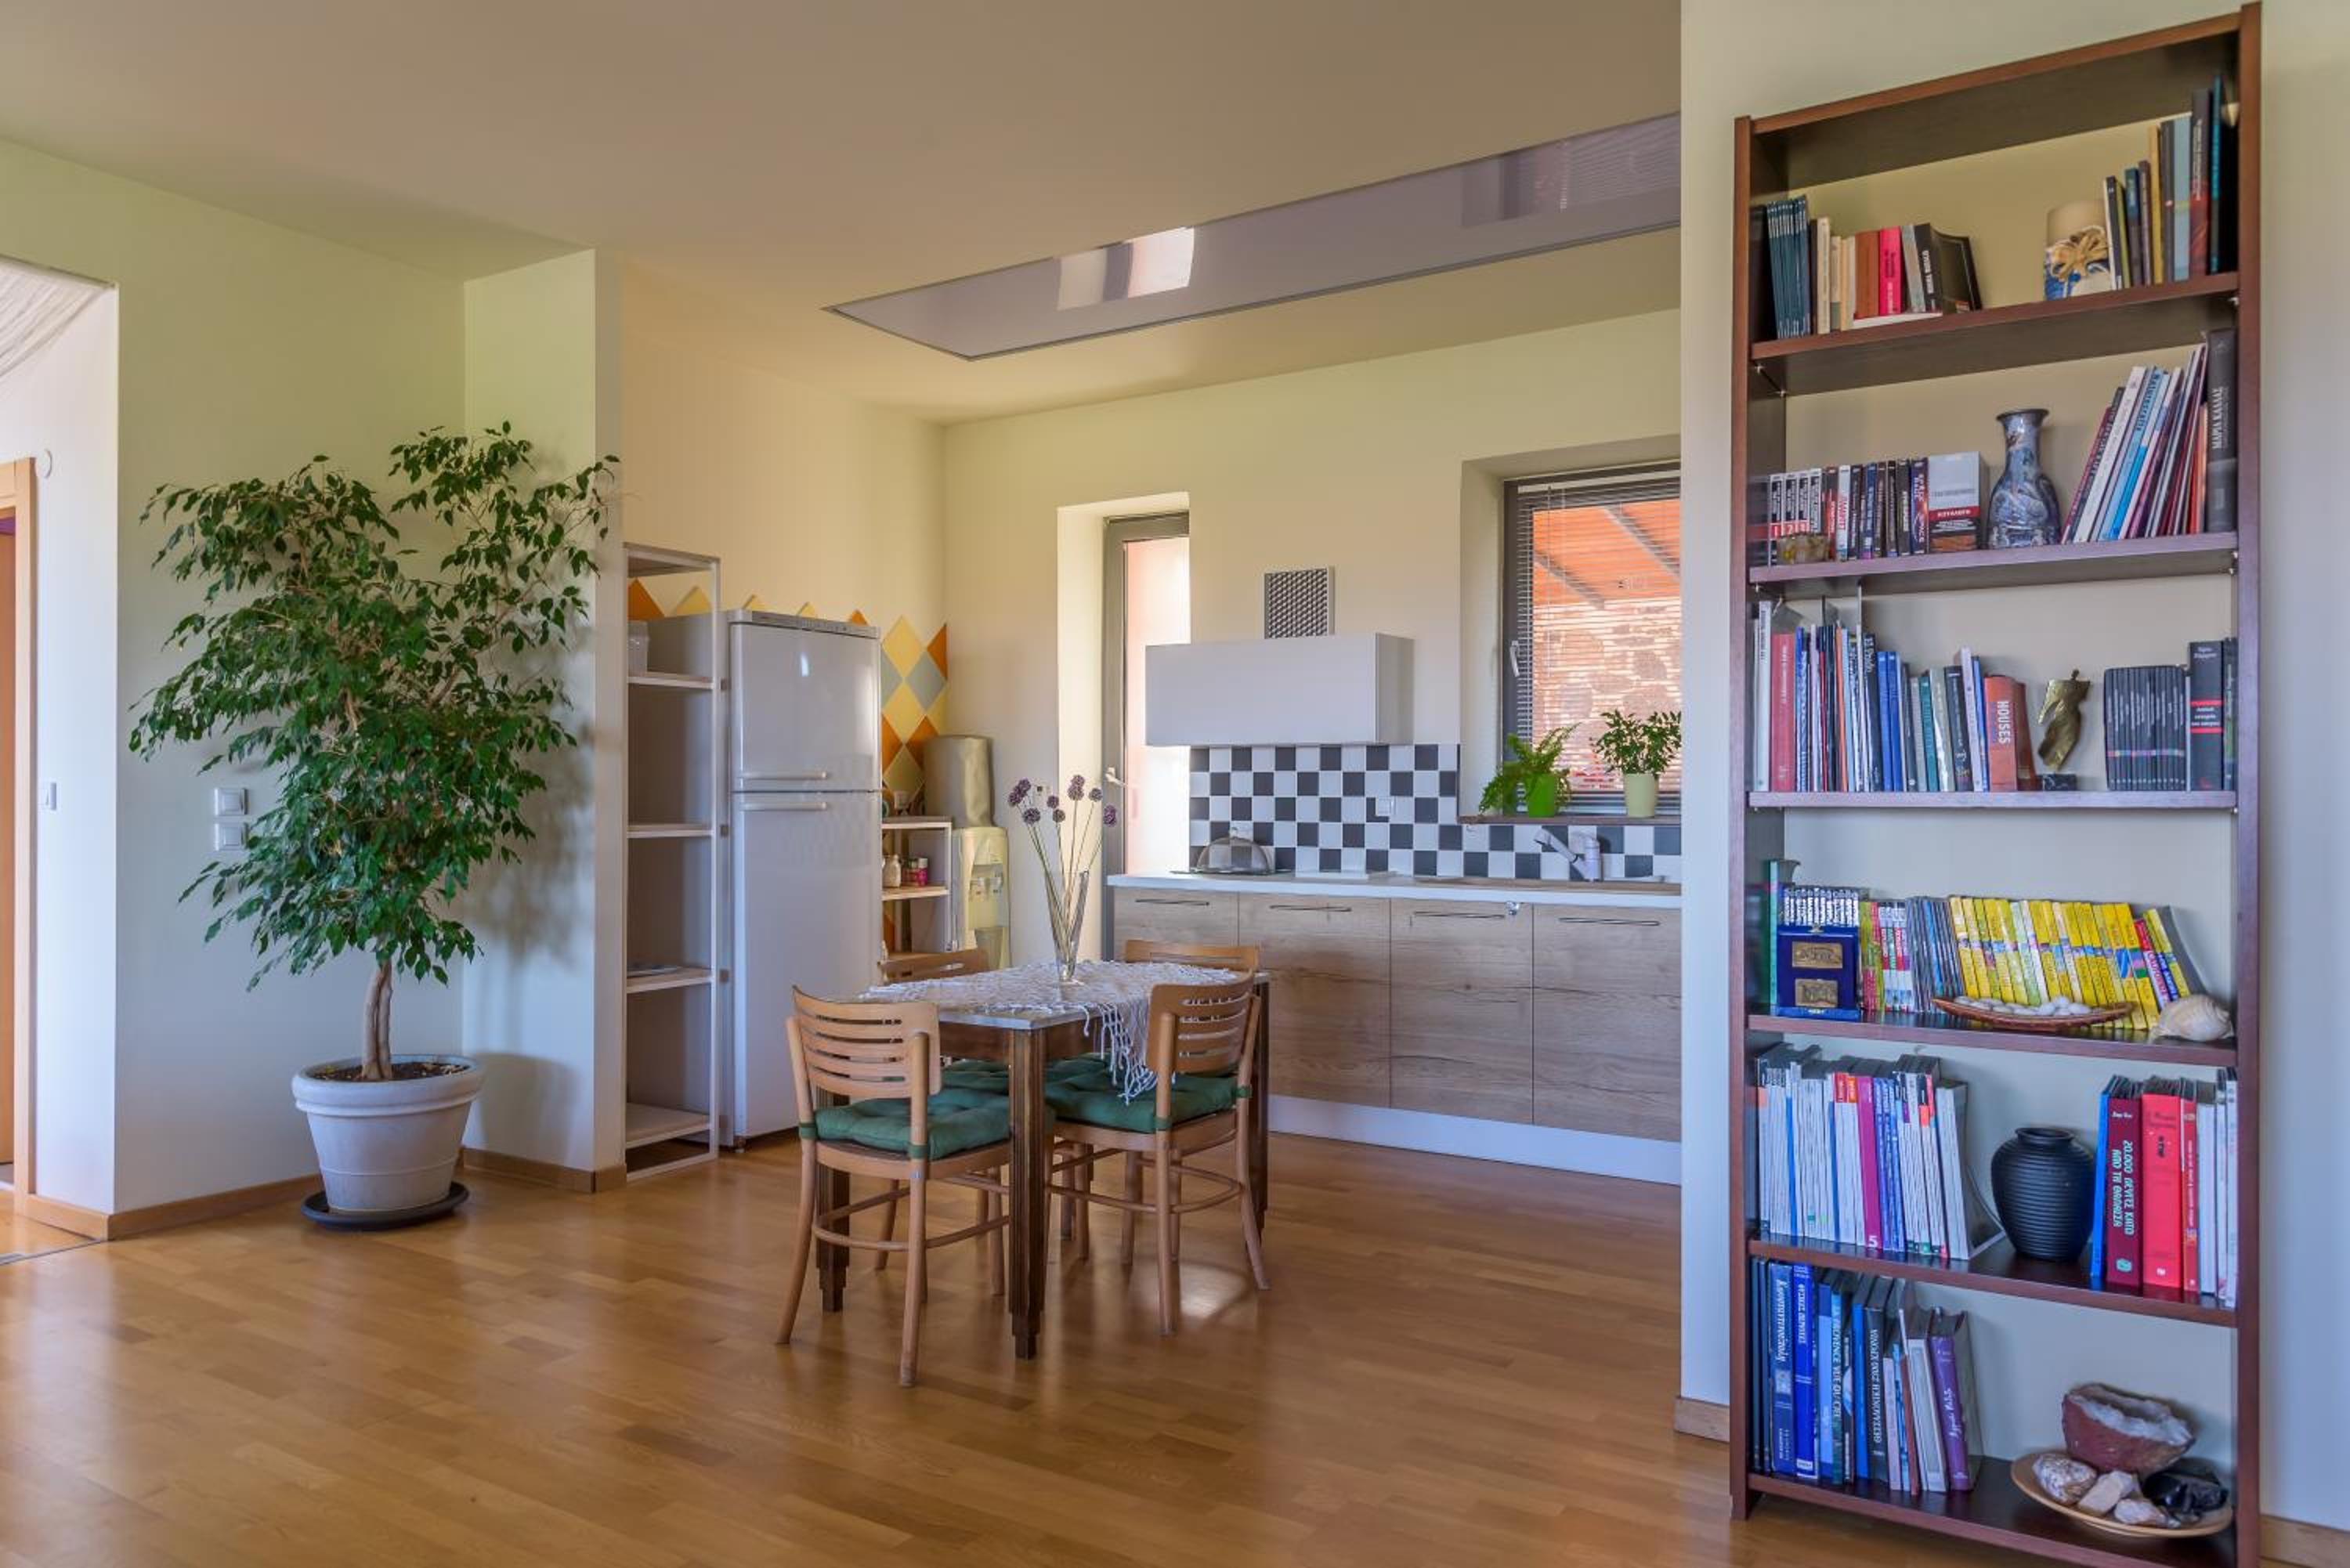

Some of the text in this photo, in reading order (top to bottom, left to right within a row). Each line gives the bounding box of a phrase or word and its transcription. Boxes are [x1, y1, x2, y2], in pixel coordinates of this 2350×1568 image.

[2136, 373, 2161, 432] Naturecrafts
[2212, 387, 2223, 449] ΜΑΡΙΑ ΚΑΛΛΑΣ
[1997, 701, 2012, 745] HOUSES
[2111, 1149, 2120, 1169] ΑΠΟ
[2113, 1185, 2123, 1228] ΘΑΛΑΣΣΑ
[2123, 1140, 2135, 1235] 20.000 ΛΕΥΓΕΣ ΚΑΤΩ
[1868, 1235, 1878, 1248] 5
[1871, 1383, 1882, 1443] ΘΕΣΣΑΛΟΝΙΚΗ
